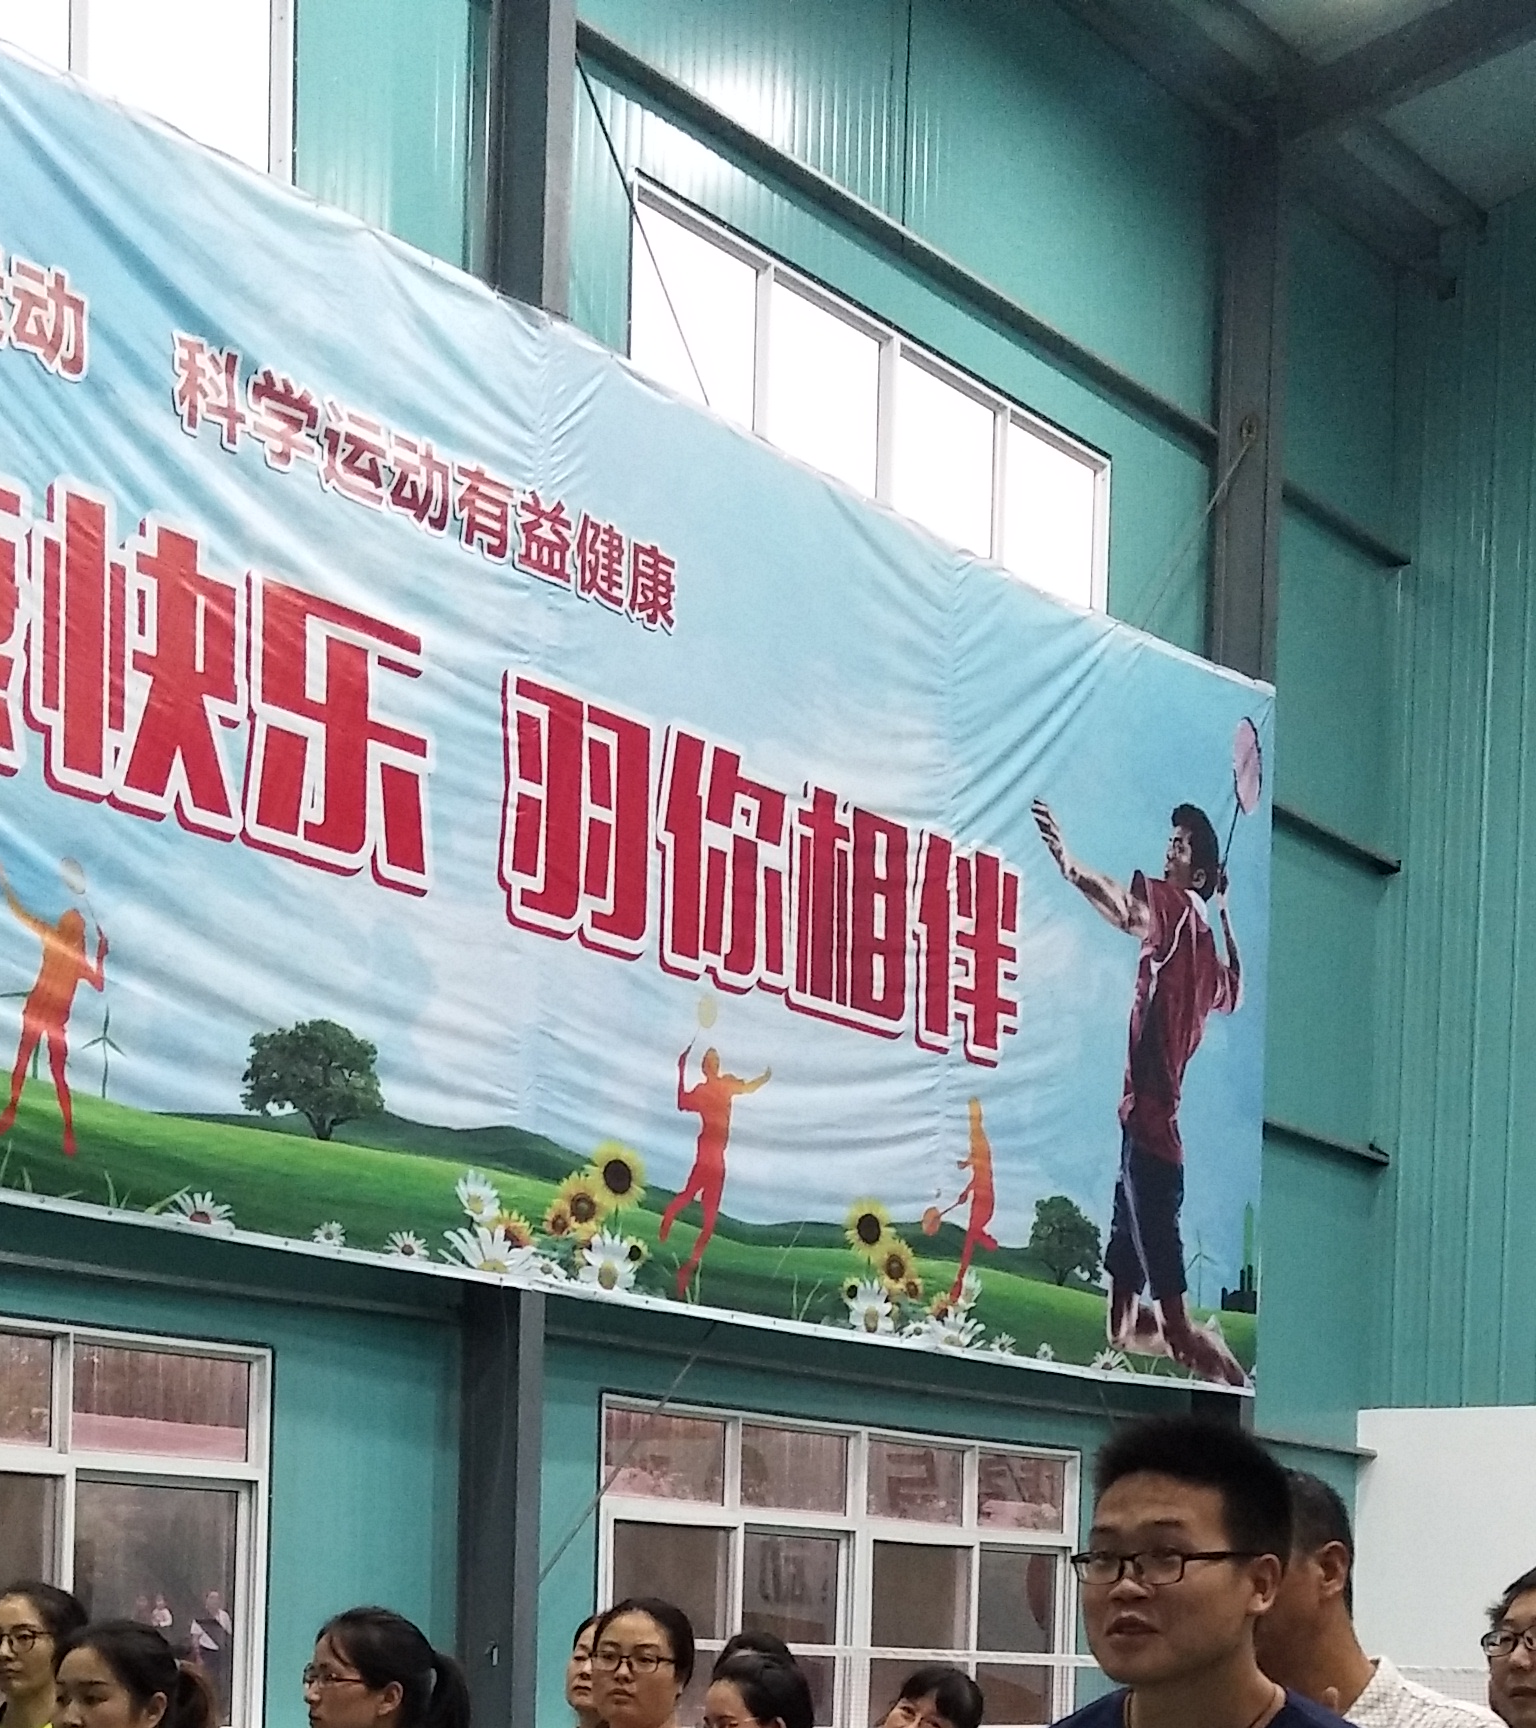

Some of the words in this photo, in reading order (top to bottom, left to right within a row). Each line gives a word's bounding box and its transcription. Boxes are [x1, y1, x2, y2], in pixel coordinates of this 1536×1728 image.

[172, 332, 677, 633] 科学运动有益健康
[498, 667, 1022, 1066] 羽你相伴
